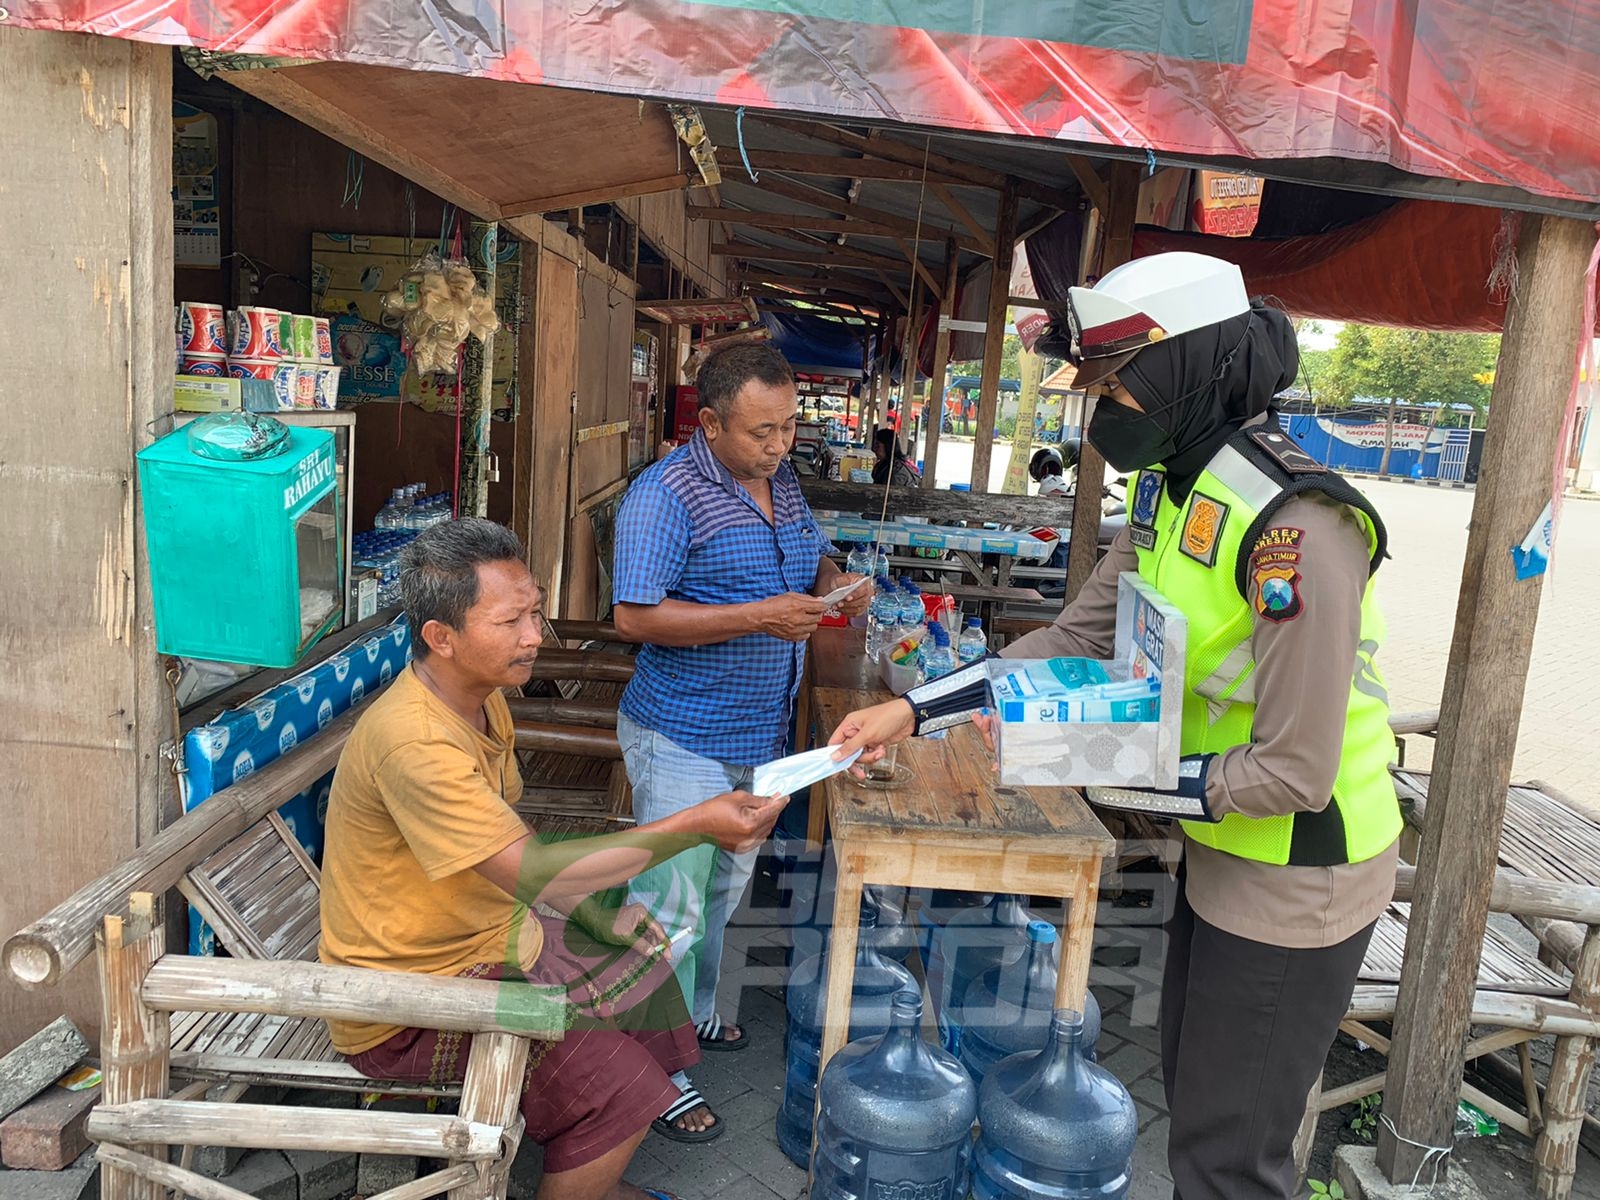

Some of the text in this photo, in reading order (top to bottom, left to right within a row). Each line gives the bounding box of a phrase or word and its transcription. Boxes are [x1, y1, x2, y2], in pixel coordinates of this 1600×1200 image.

[353, 366, 396, 383] ESSE
[299, 448, 320, 476] SRI
[284, 457, 332, 510] RAHAYU
[1256, 553, 1297, 565] JAWA TIMUR
